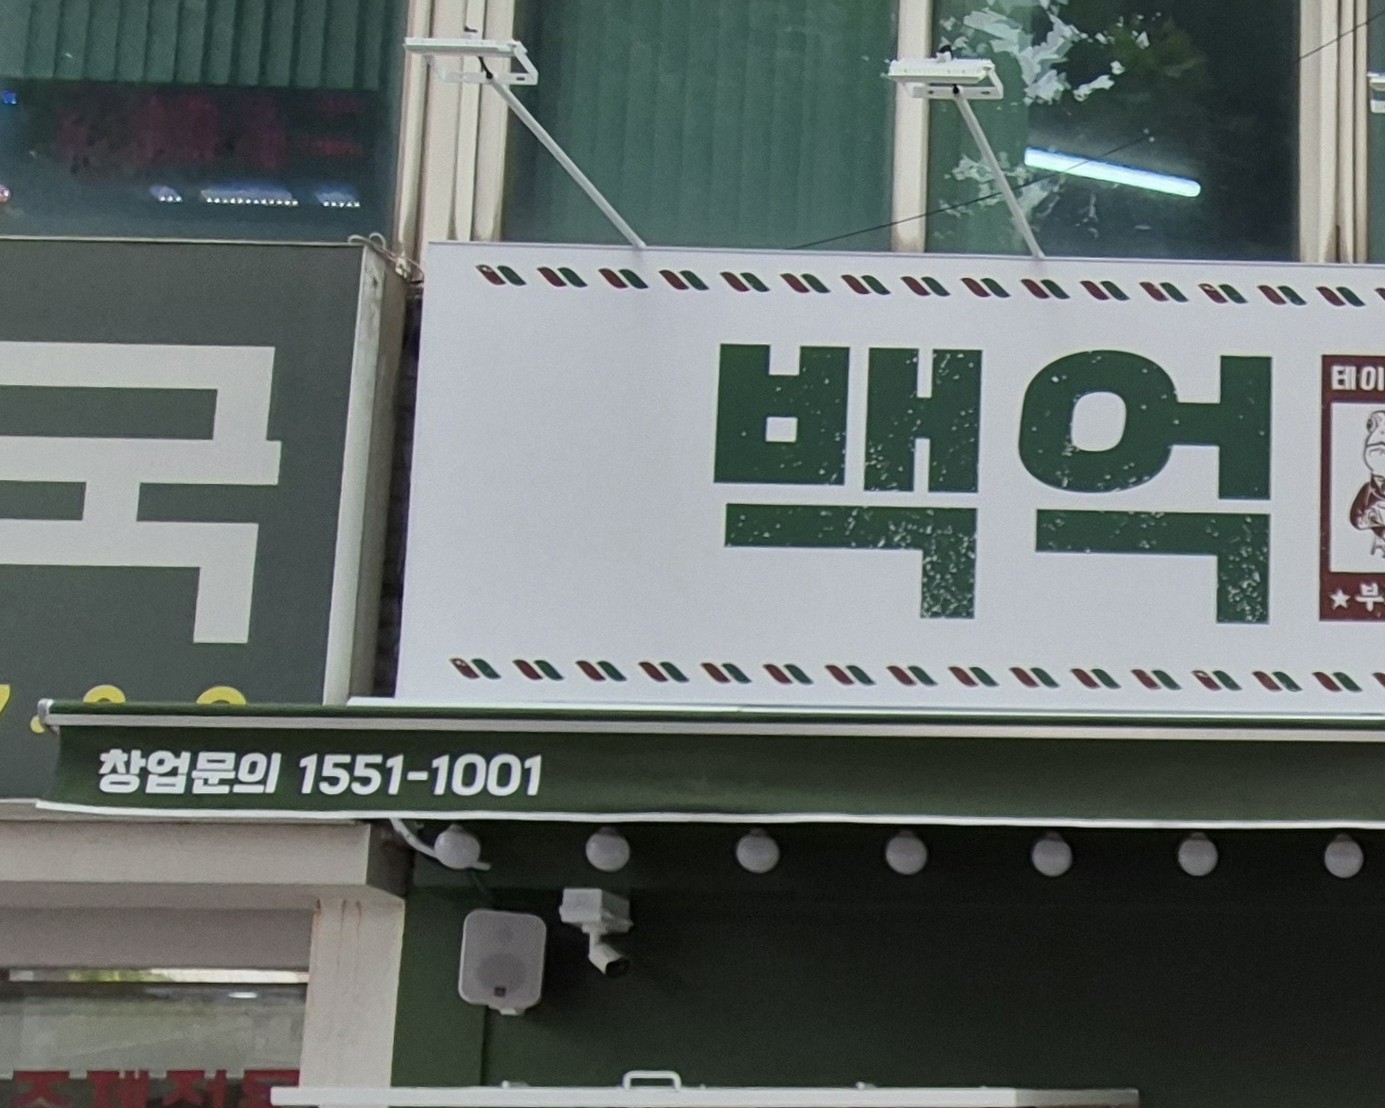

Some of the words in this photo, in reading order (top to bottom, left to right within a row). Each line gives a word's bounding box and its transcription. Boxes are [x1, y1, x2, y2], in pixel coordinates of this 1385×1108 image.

[714, 343, 1273, 624] 백억
[98, 748, 281, 795] 창업문의
[298, 753, 543, 796] 1551-1001
